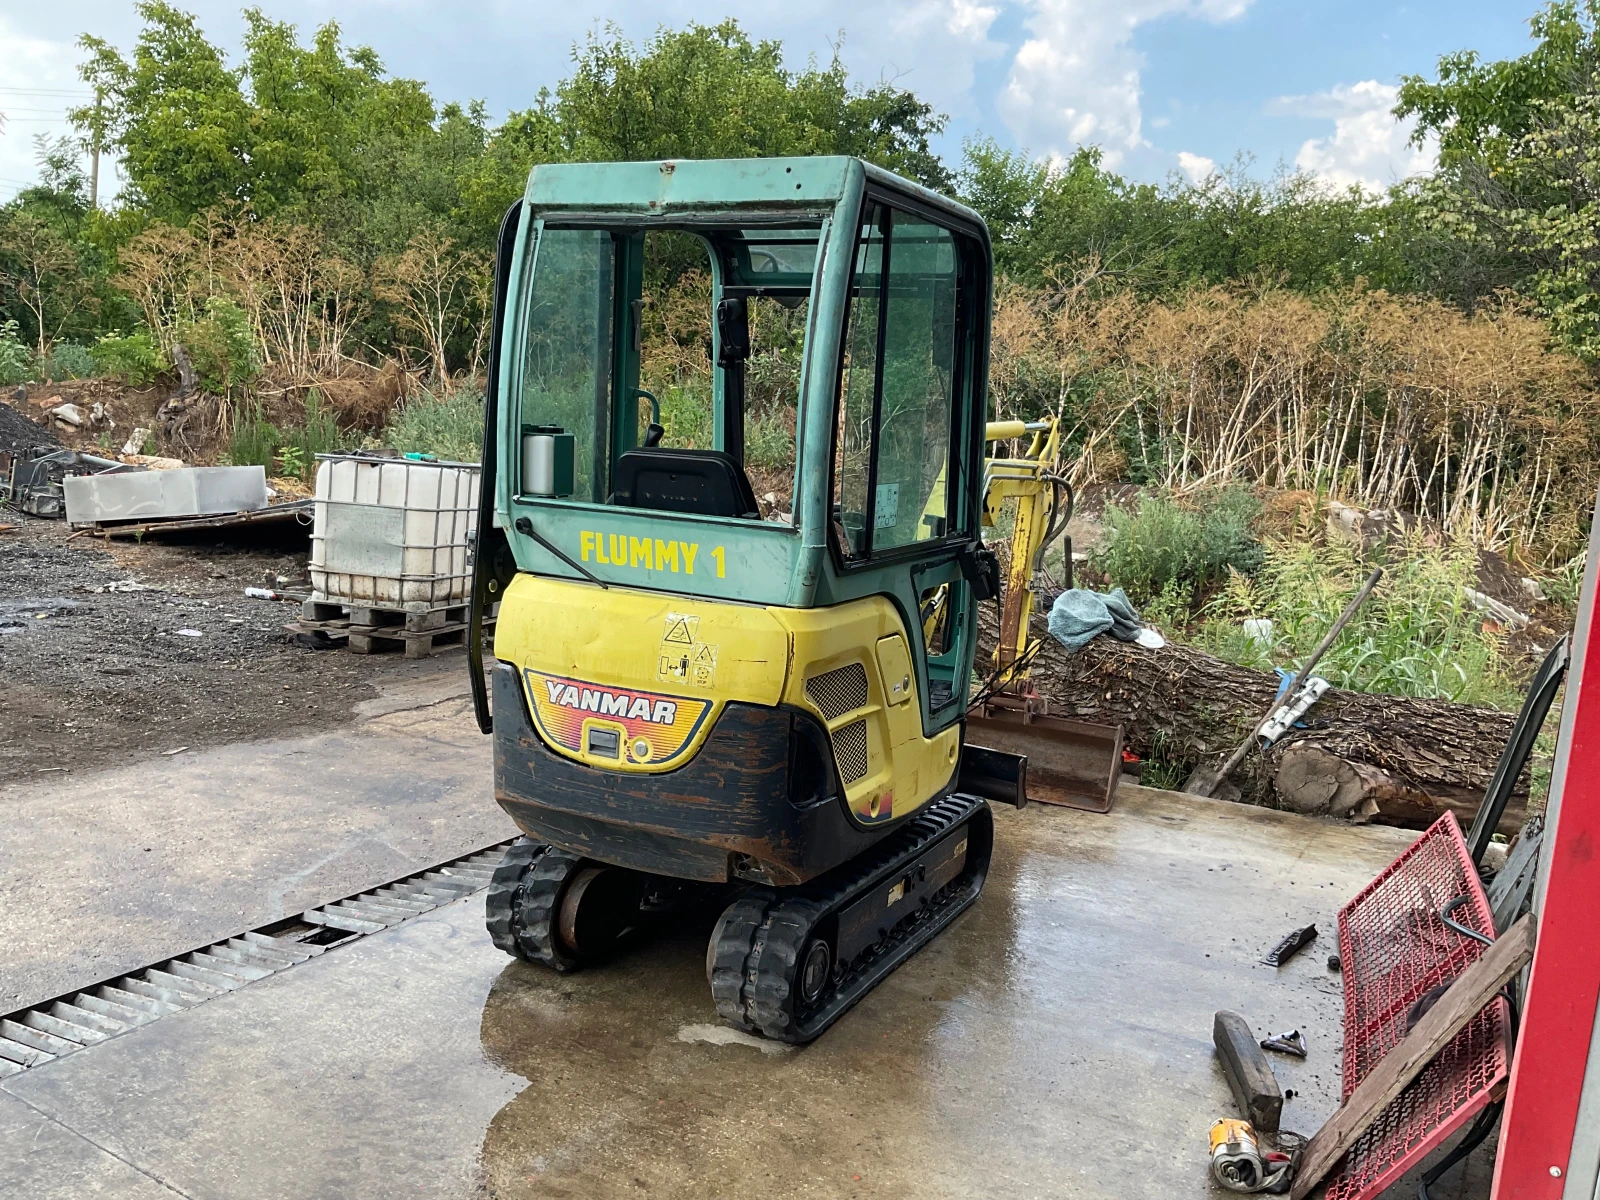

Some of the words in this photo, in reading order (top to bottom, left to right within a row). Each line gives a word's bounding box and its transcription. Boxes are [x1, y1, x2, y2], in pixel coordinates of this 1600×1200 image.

[580, 530, 699, 574] FLUMMY
[711, 545, 726, 579] 1
[545, 680, 677, 725] YANMAR
